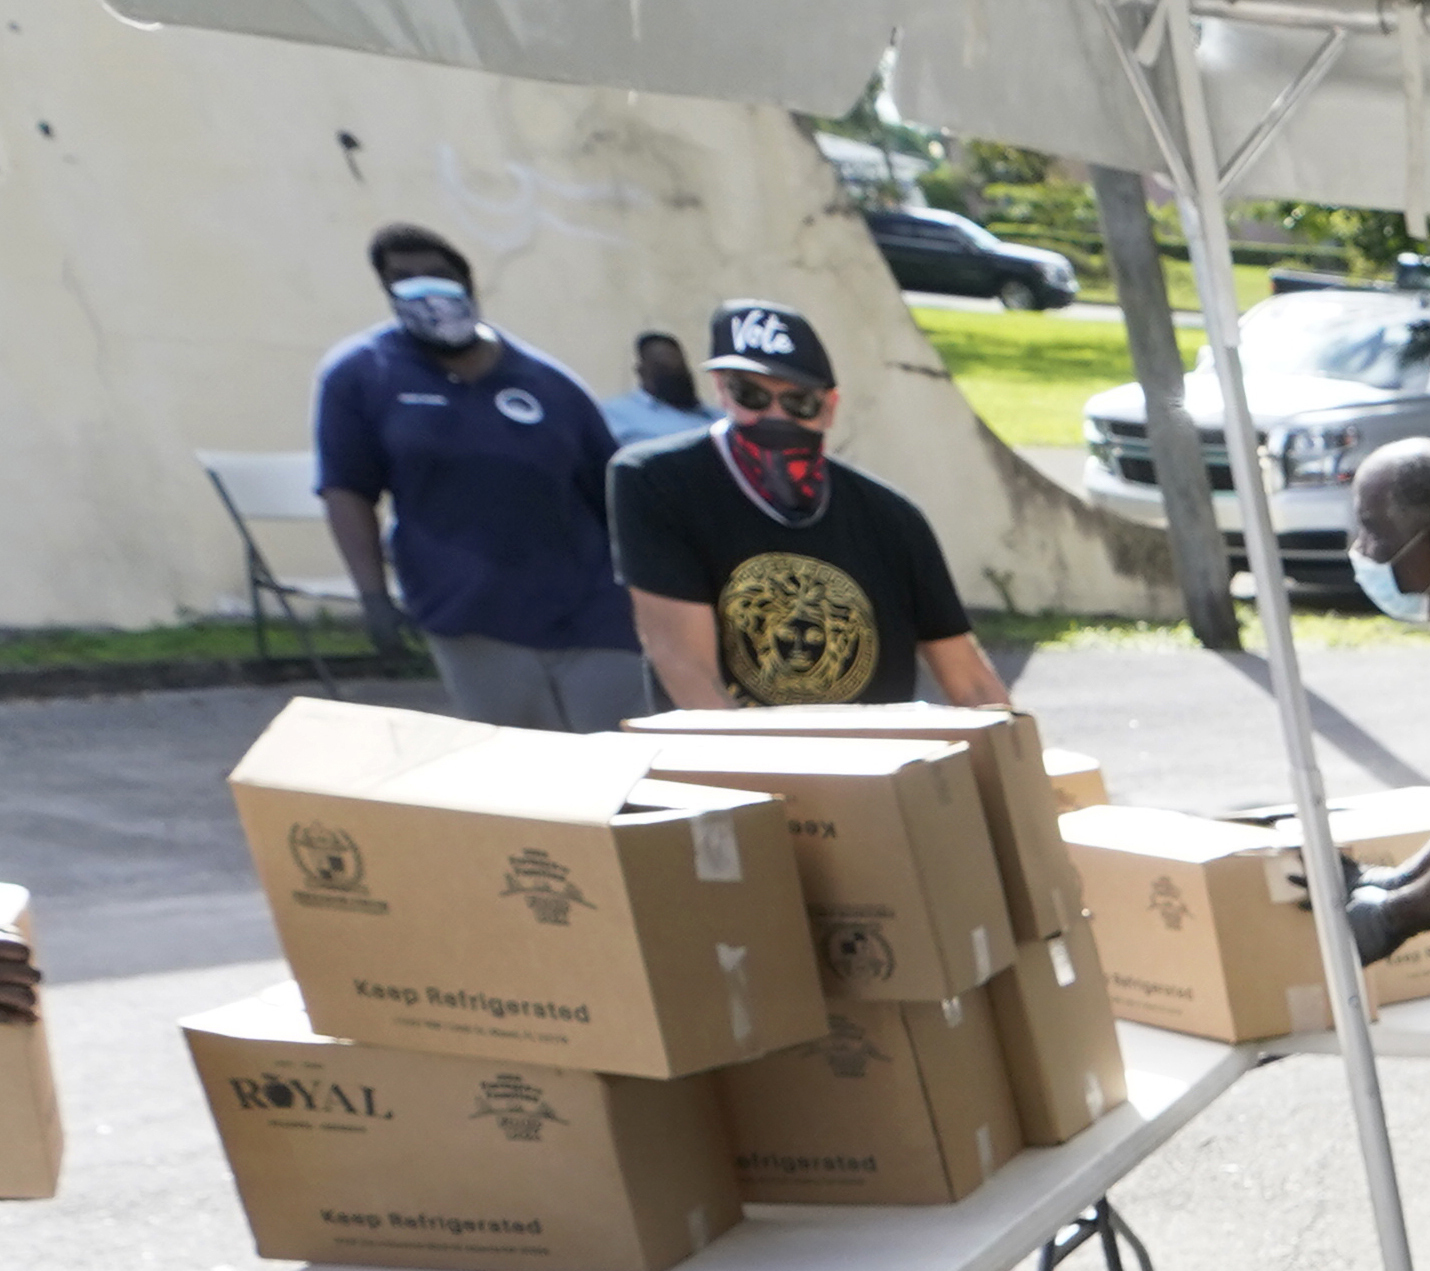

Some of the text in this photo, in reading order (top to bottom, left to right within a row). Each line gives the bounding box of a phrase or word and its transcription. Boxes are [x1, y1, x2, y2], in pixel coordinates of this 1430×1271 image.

[731, 309, 795, 354] Vote
[353, 978, 591, 1024] Keep Refrigerated
[229, 1072, 395, 1120] ROYAL
[736, 1152, 878, 1174] efrigerated
[320, 1208, 543, 1235] Keep Refrigerated
